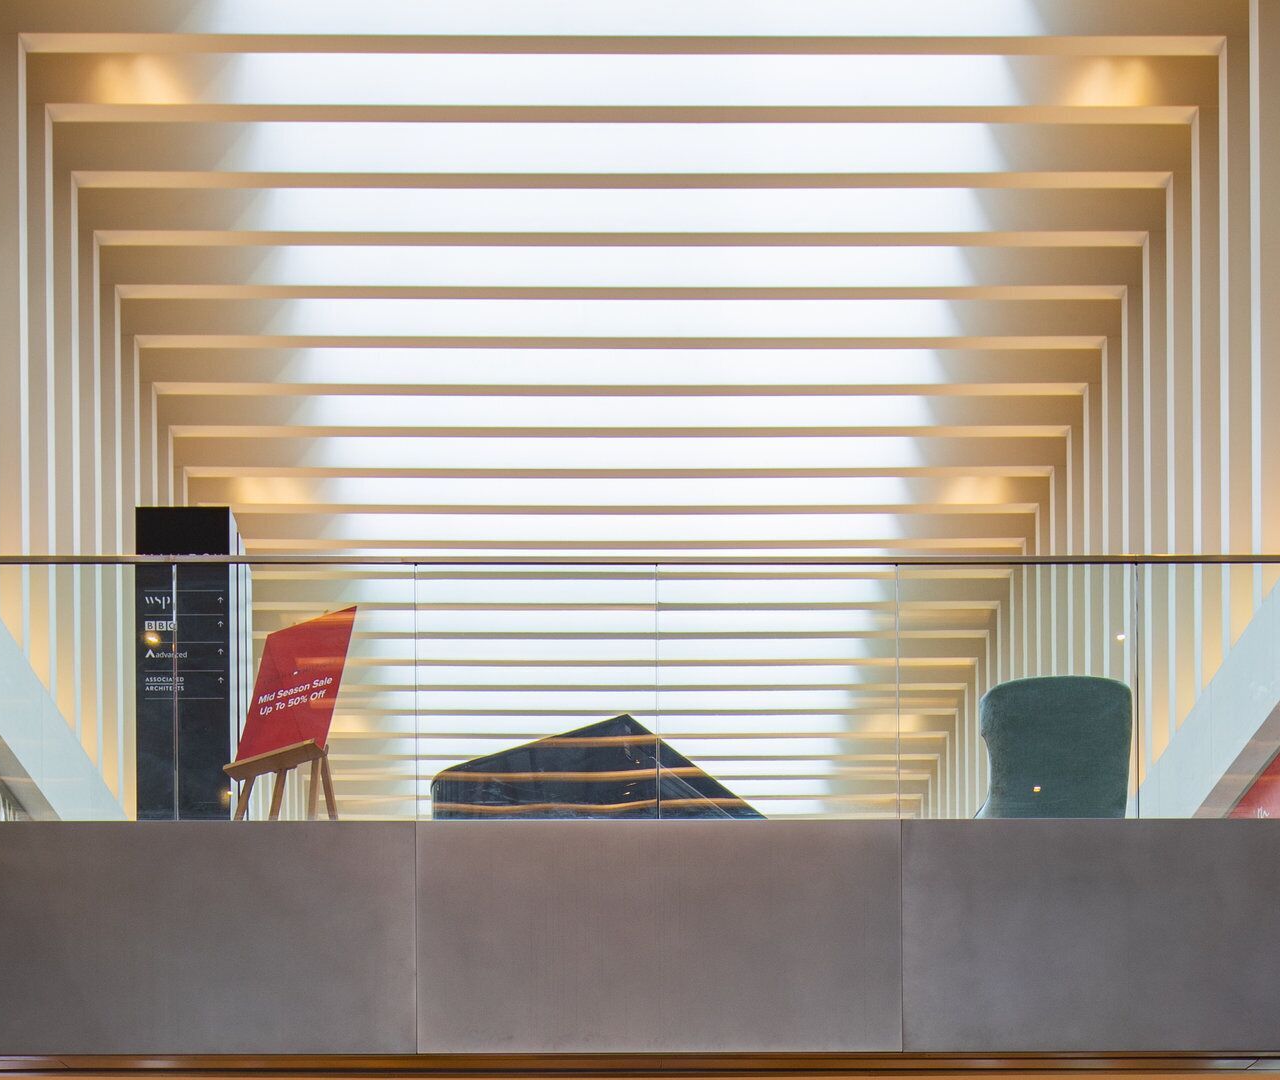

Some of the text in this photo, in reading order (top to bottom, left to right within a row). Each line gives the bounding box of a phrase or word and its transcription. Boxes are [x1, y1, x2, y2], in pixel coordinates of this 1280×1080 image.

[145, 596, 170, 609] wsp
[258, 693, 276, 704] Mid
[276, 683, 310, 699] Season
[312, 677, 333, 688] Sale
[259, 689, 327, 716] Up To 50% Off
